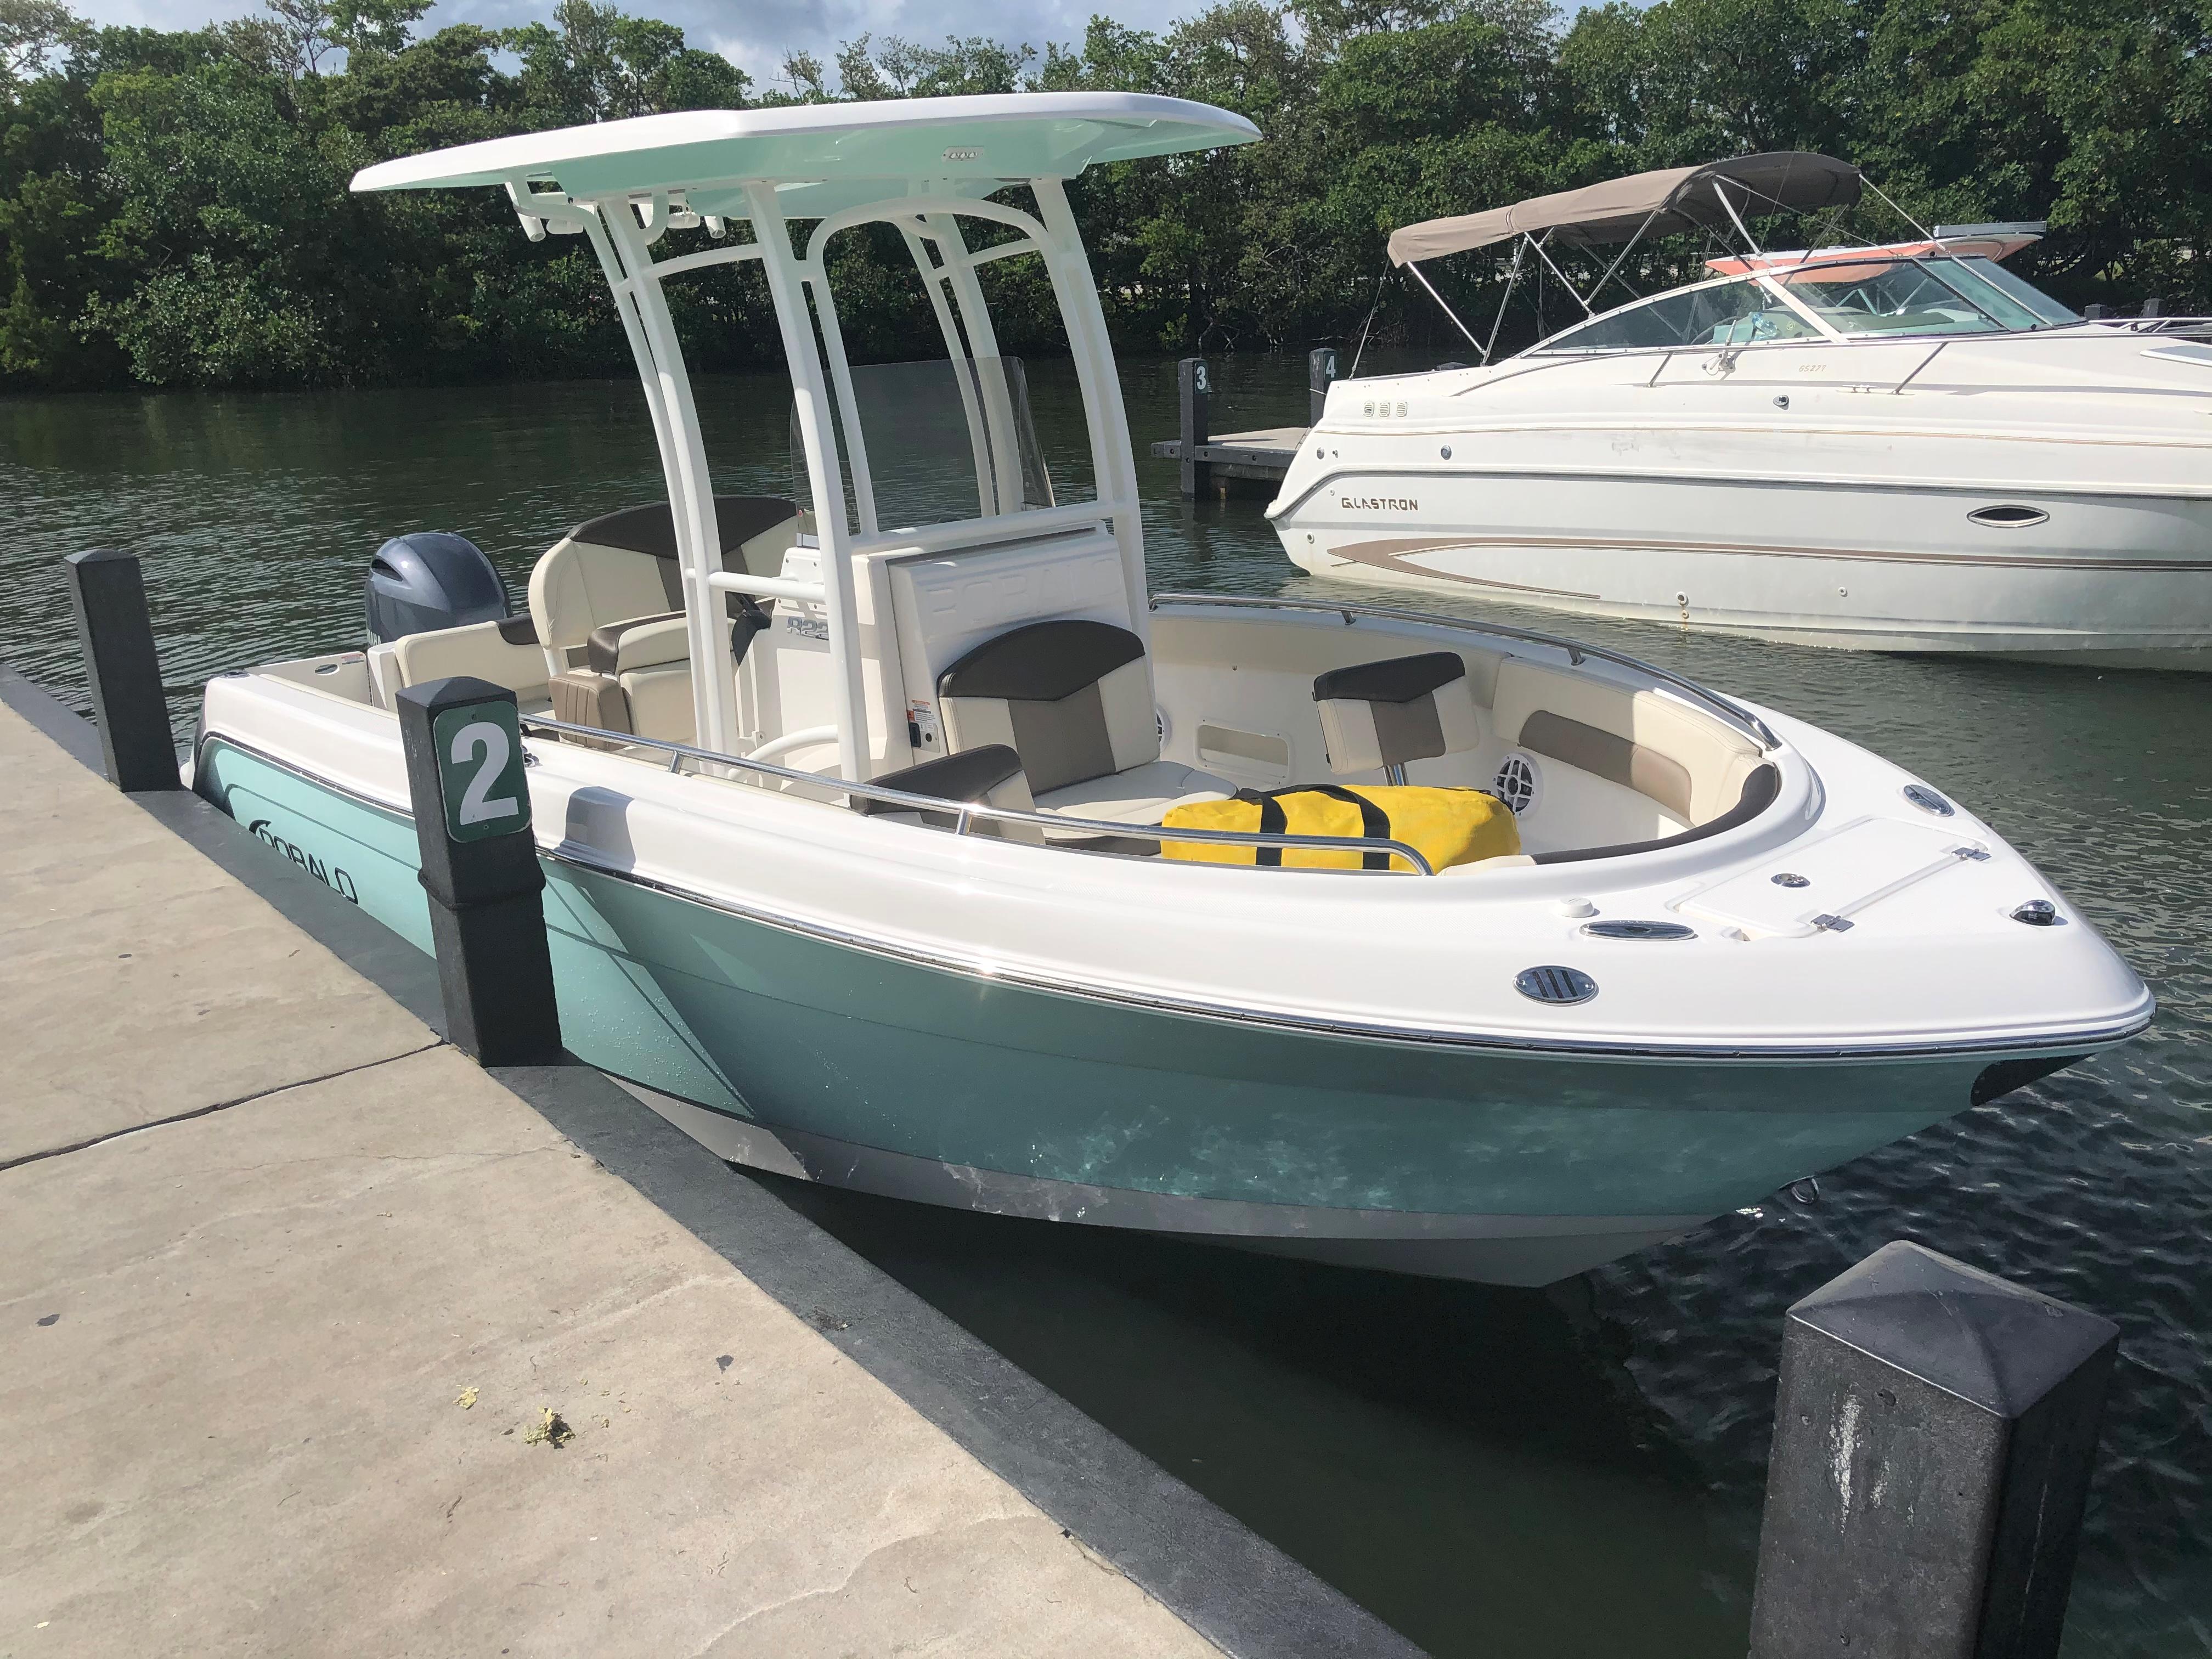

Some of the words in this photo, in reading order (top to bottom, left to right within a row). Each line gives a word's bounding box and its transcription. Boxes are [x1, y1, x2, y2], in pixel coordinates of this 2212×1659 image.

[1196, 366, 1206, 390] 3
[1325, 356, 1336, 378] 4
[1341, 497, 1419, 511] GLASTRON
[451, 721, 519, 826] 2
